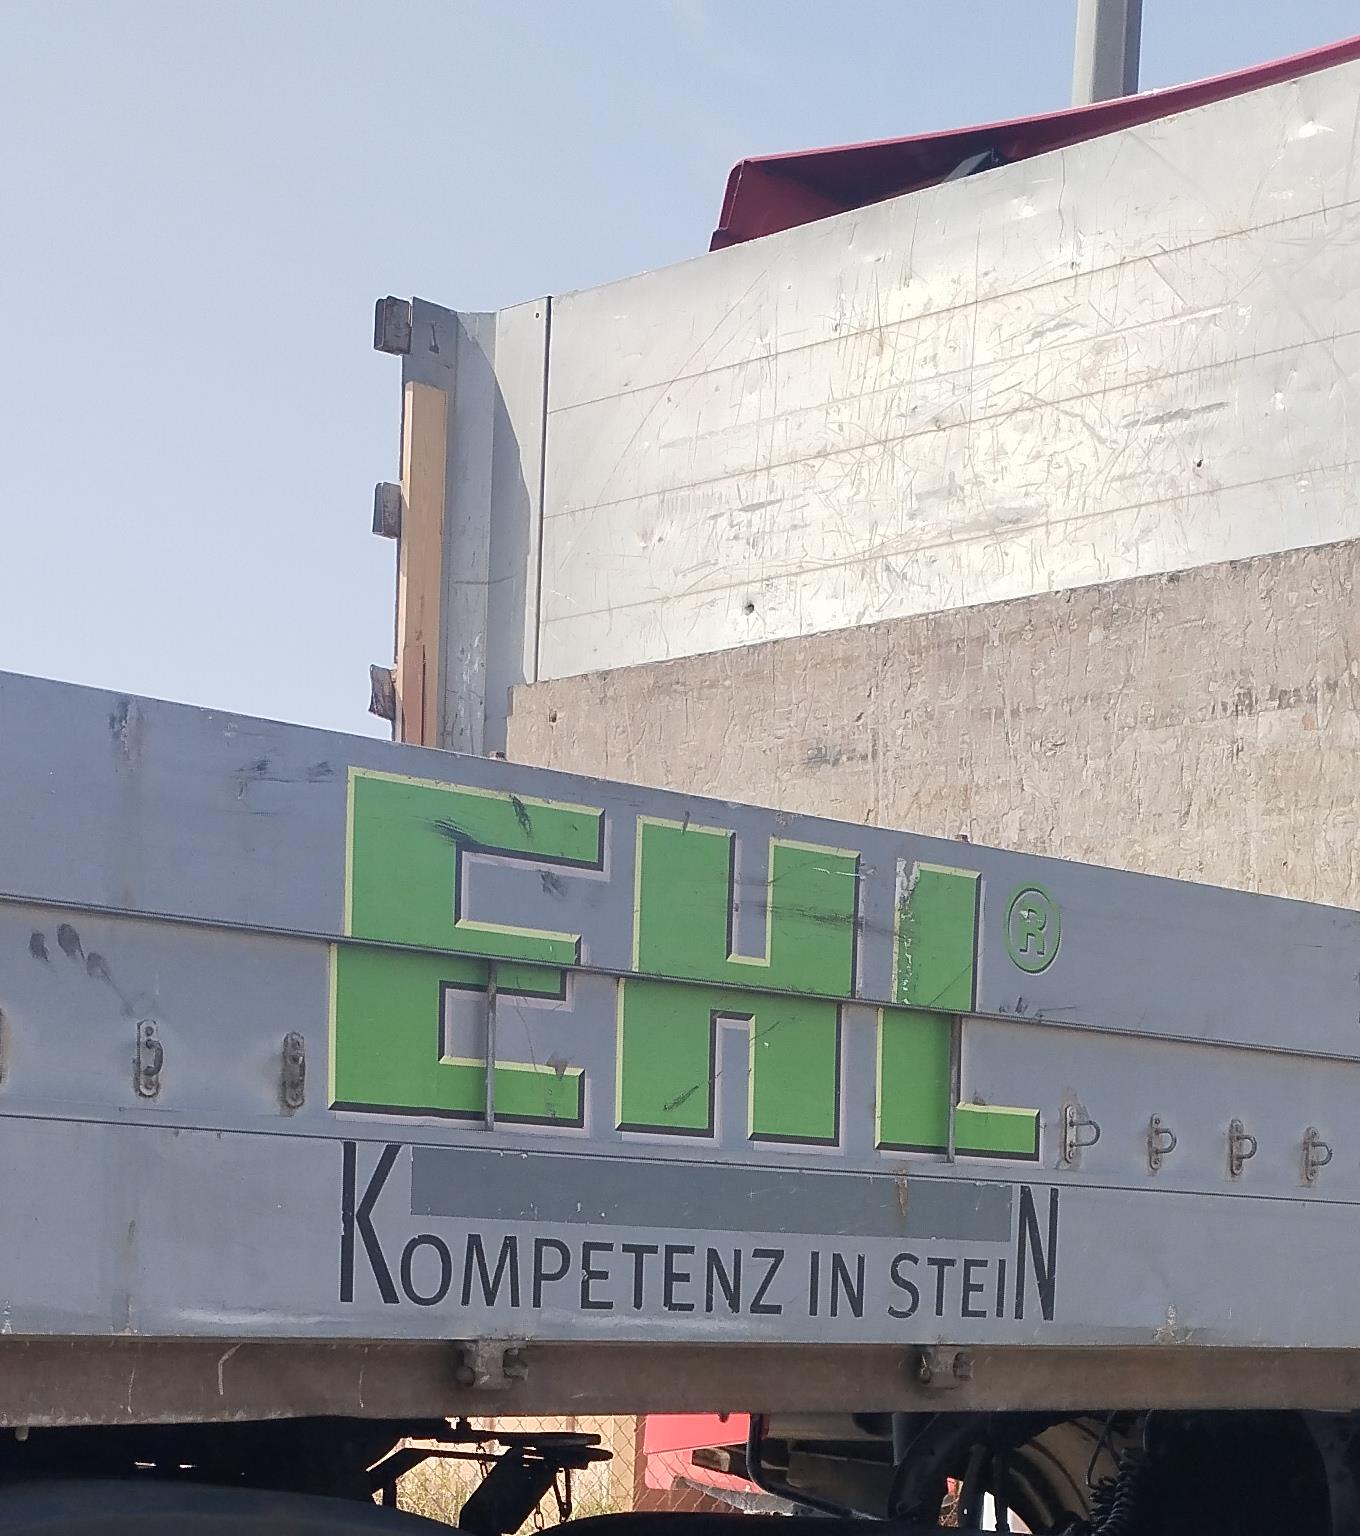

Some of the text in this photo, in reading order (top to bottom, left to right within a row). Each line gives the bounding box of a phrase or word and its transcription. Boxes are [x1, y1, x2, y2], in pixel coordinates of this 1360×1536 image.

[328, 765, 1040, 1162] EHL
[340, 1140, 1059, 1322] KOMPETENZ IN STEIN
